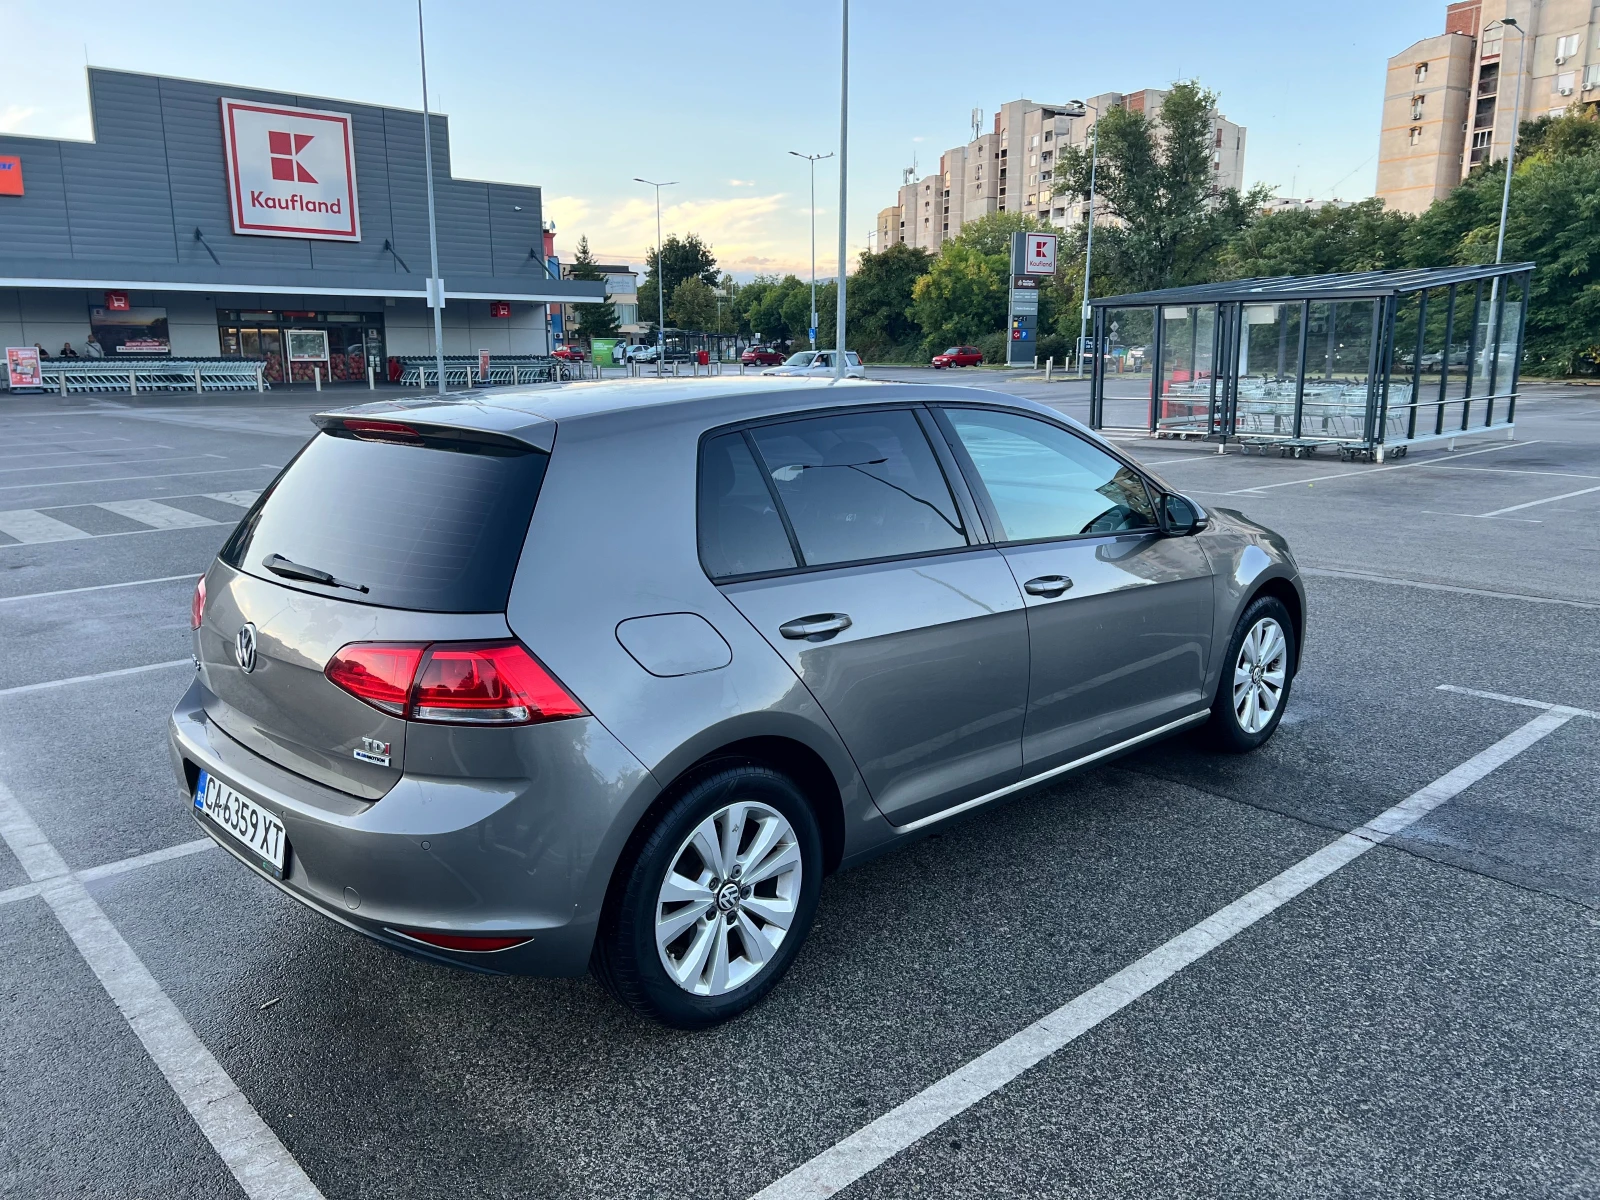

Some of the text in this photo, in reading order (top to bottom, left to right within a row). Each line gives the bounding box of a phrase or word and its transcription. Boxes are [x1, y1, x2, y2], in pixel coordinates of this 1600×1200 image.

[250, 190, 342, 215] Kaufland
[1029, 260, 1053, 268] Kaufland
[361, 736, 391, 756] TDI
[223, 791, 259, 843] 6359
[260, 815, 283, 860] XT
